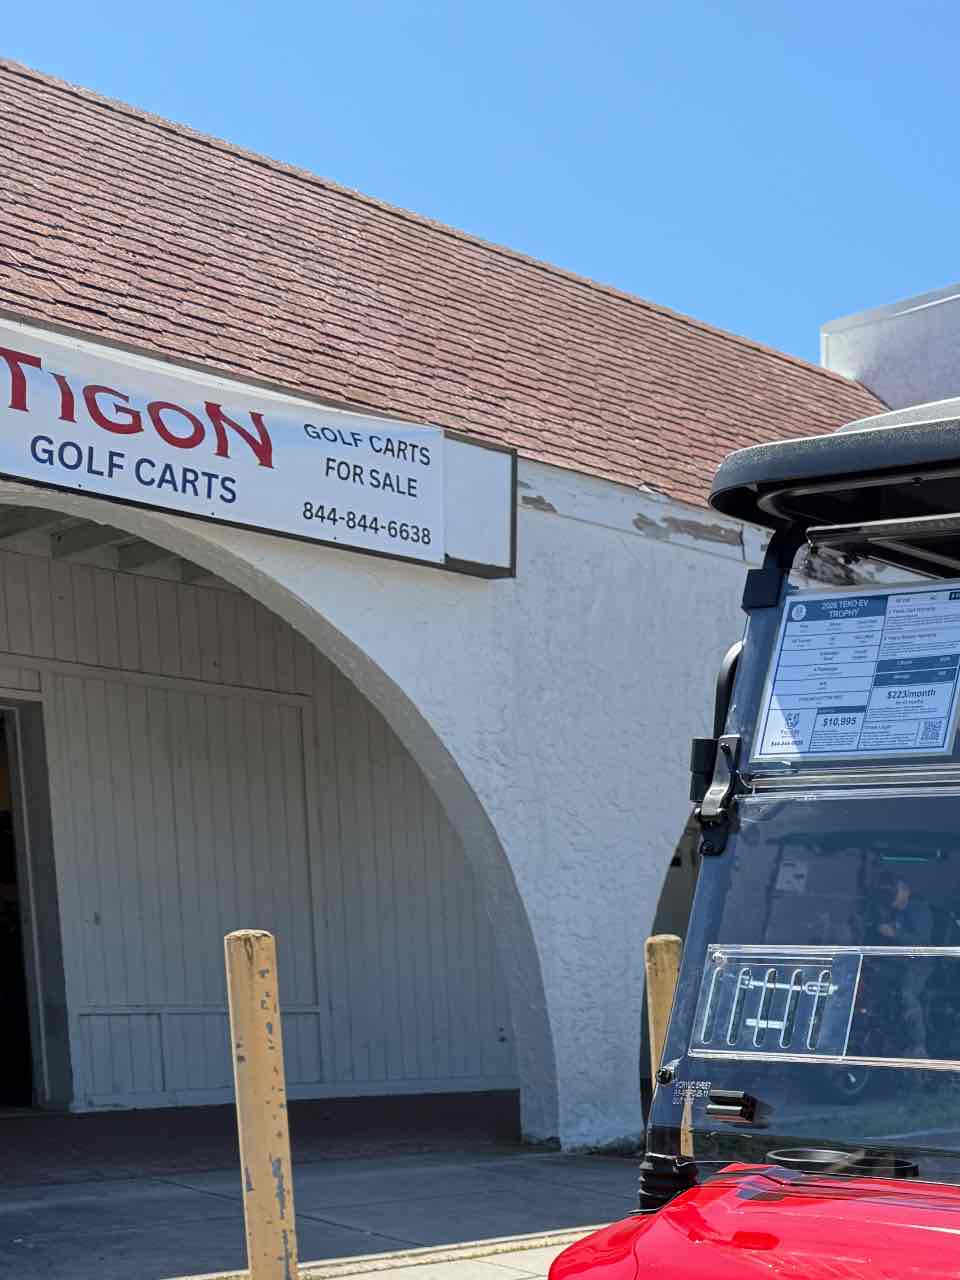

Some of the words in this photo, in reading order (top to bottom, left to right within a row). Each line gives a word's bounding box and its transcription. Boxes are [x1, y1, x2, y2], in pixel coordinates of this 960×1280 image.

[0, 347, 274, 469] TIGON
[304, 423, 363, 448] GOLF
[369, 435, 431, 466] CARTS
[30, 435, 126, 478] GOLF
[135, 457, 237, 503] CARTS
[325, 456, 364, 485] FOR
[369, 468, 418, 498] SALE
[303, 501, 431, 545] 844-844-6638
